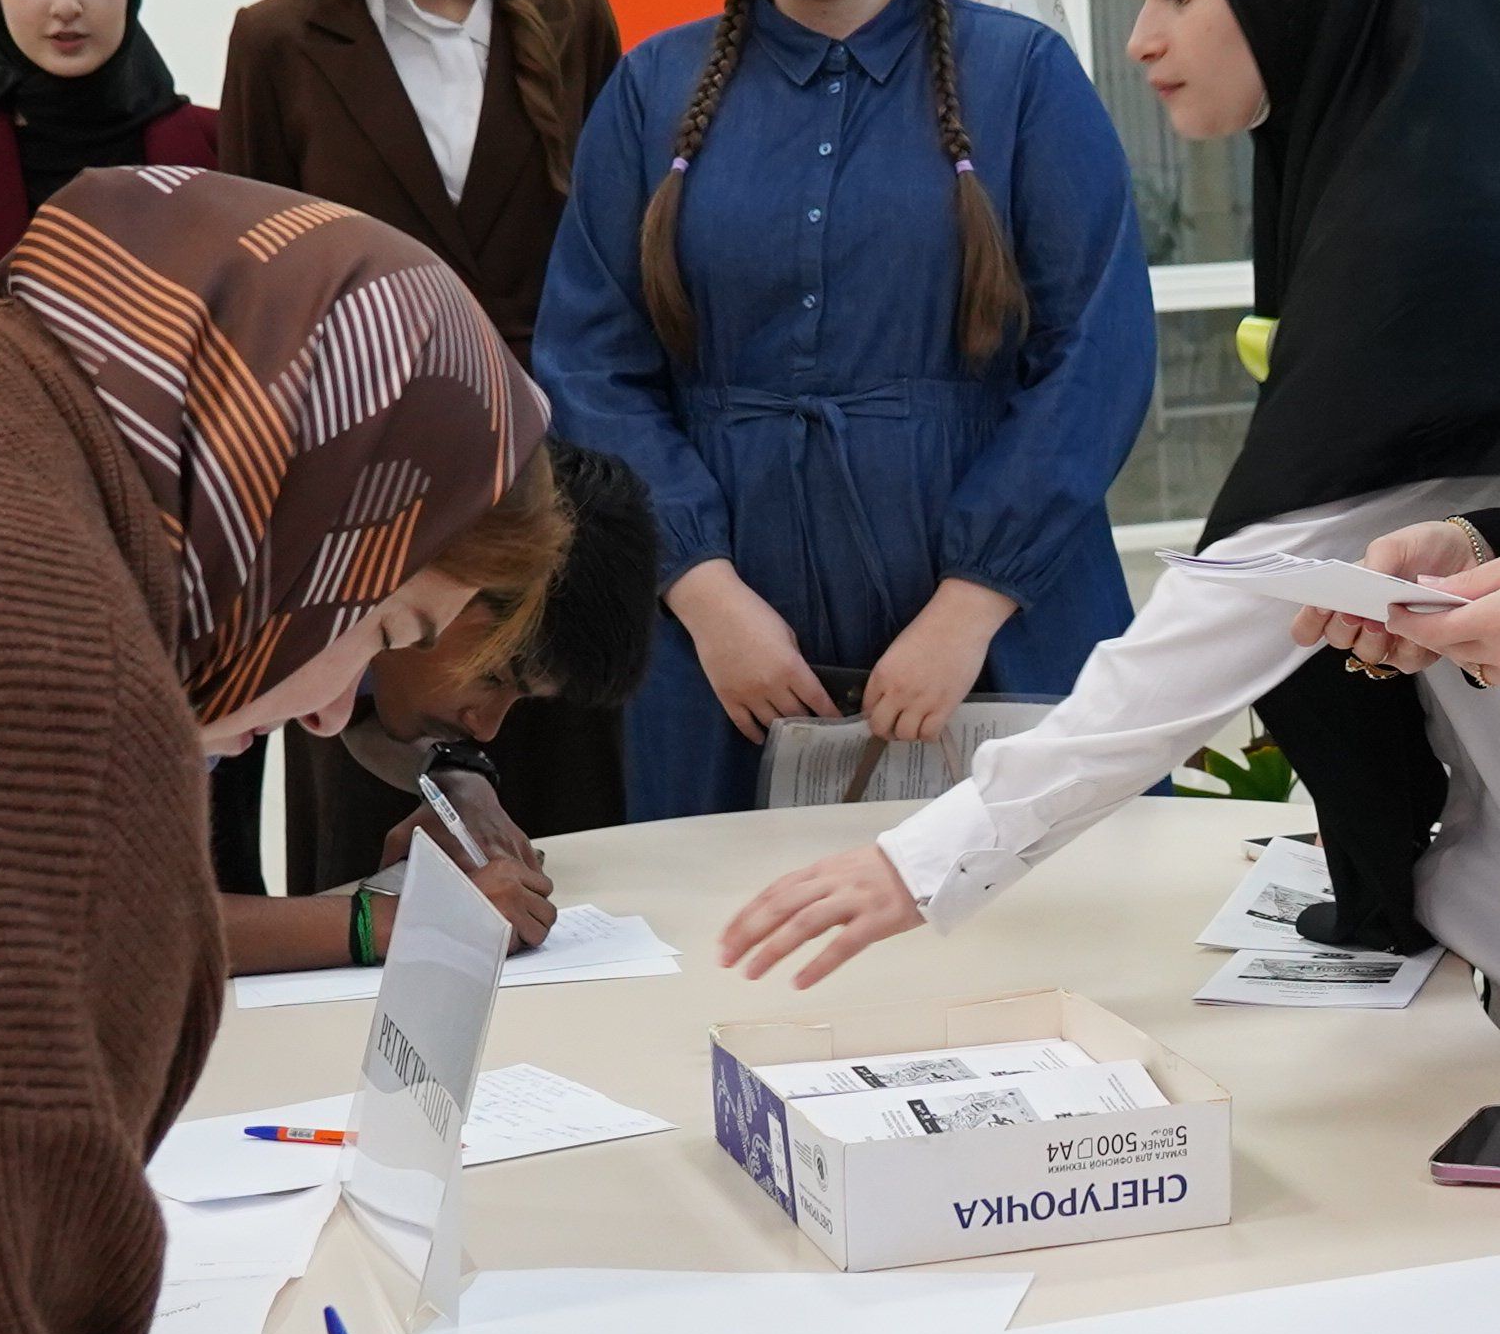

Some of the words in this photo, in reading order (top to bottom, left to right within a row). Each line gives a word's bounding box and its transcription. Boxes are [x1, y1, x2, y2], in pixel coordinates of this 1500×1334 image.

[378, 1012, 453, 1143] РЕГИСТРАЦИЯ
[1175, 1125, 1188, 1146] 5
[1097, 1132, 1137, 1156] 500
[1141, 1137, 1174, 1151] ПАЧЕК
[1135, 1153, 1152, 1162] ДЛЯ
[1155, 1148, 1188, 1159] БУМАГА
[1048, 1162, 1086, 1174] ТЕХНИКИ
[1089, 1157, 1133, 1169] ОФИСНОЙ
[953, 1173, 1188, 1229] СНЕГУРОЧКА
